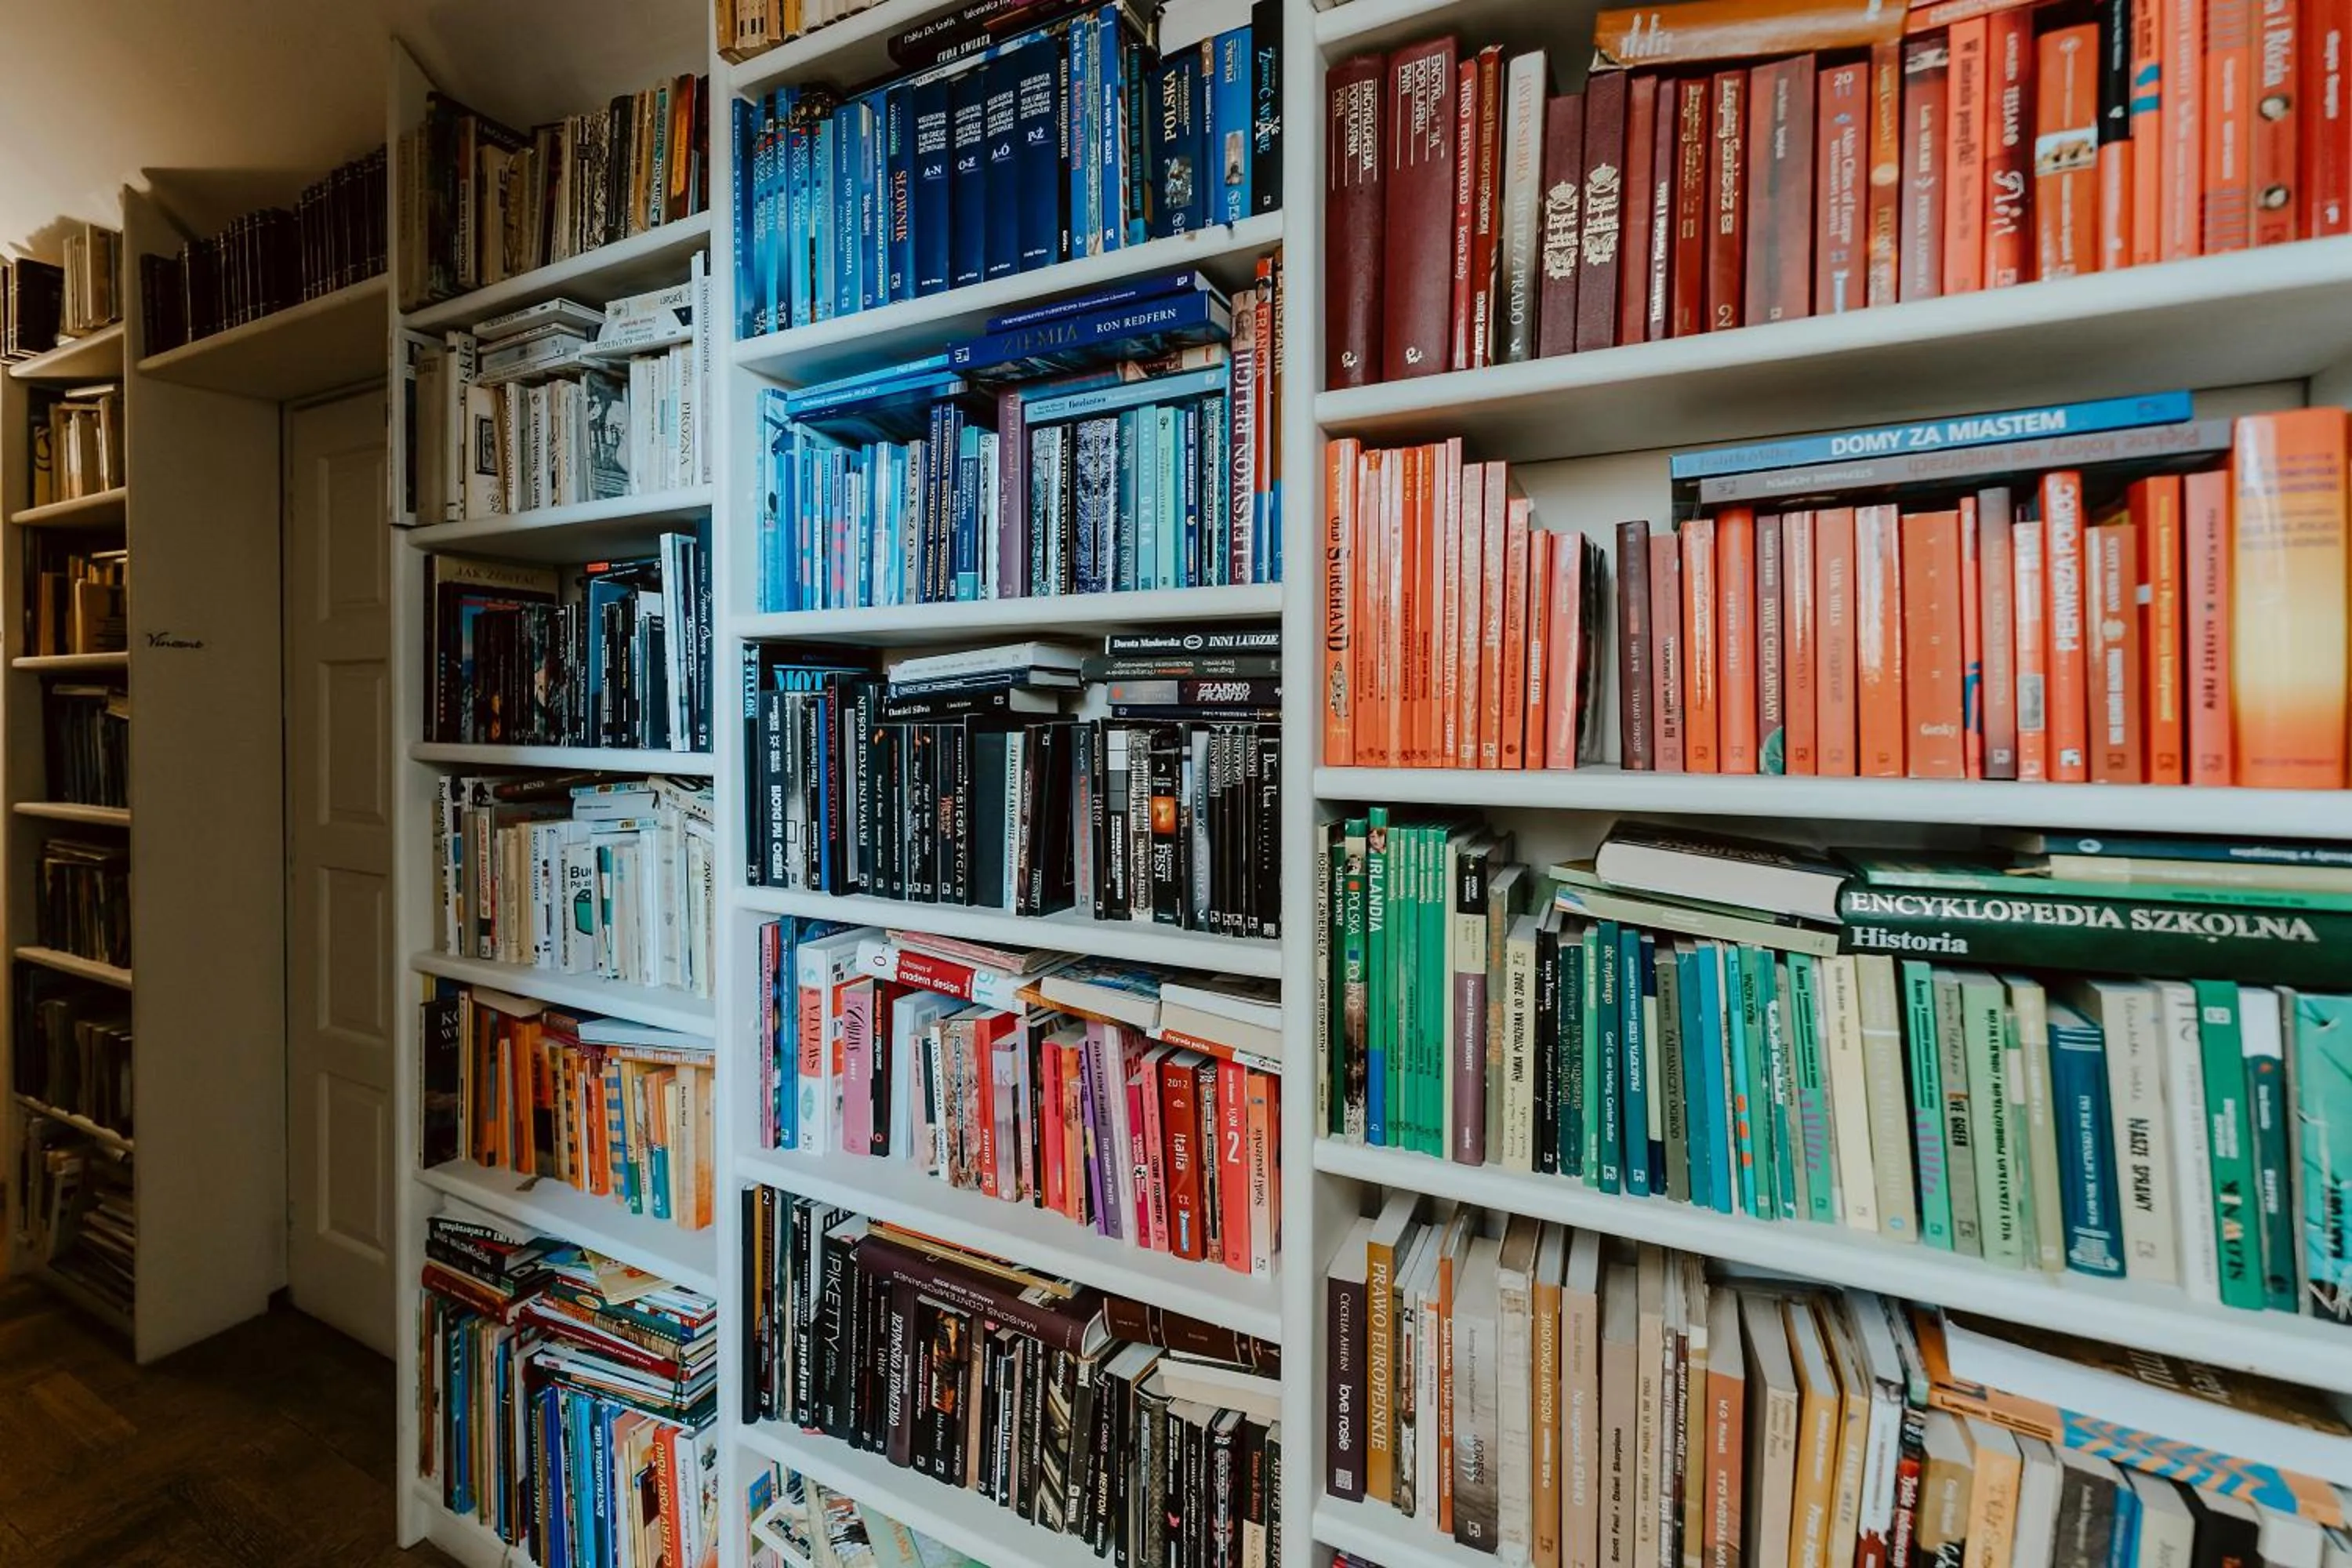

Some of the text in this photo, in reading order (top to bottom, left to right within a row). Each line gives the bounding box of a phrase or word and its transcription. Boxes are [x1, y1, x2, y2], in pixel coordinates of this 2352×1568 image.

[1224, 38, 1233, 83] POLSKA
[1401, 64, 1413, 94] PWN
[1162, 70, 1177, 143] POLSKA
[1335, 88, 1346, 117] PWN
[1348, 83, 1359, 157] POPULARNA
[1414, 59, 1427, 135] POPULARNA
[1461, 79, 1472, 118] WINO
[895, 171, 907, 241] SŁOWNIK
[1096, 308, 1177, 334] RON REDFERN
[1510, 270, 1525, 325] PRADO
[1255, 307, 1268, 377] FRANCJA
[1232, 354, 1252, 558] LEKSYKON RELIGII
[1831, 409, 2067, 457] DOMY ZA MIASTEM
[2050, 484, 2079, 652] PIERWSZA POMOC
[1327, 547, 1351, 652] SUREHAND
[1208, 635, 1234, 648] INNI
[1236, 633, 1280, 647] LUDZIE
[1763, 598, 1778, 723] KWIAT CIEPLARNIANY
[888, 705, 931, 717] Daniel Silva
[1196, 691, 1251, 702] PRAWDY
[1199, 681, 1250, 693] ZIARNO
[857, 696, 867, 846] PRYWATNE ŻYCIE ROŚLIN
[955, 786, 964, 838] KSIĘGA
[1093, 793, 1104, 826] Lektor
[771, 842, 782, 878] NIEBO
[1154, 844, 1167, 881] FEST
[1316, 853, 1327, 894] ROŚLINY
[1368, 859, 1384, 932] IRLANDIA
[1849, 891, 2318, 942] ENCYKLOPEDIA SZKOLNA
[1316, 903, 1327, 957] ZWIERZĘTA
[1347, 891, 1361, 1010] POLSKA POLAND
[1605, 945, 1615, 960] abc
[1851, 926, 1969, 955] Historia
[899, 971, 960, 994] modern design
[1167, 1077, 1187, 1088] 2012
[1562, 1040, 1571, 1105] PSYCHOLOGII
[1664, 1029, 1680, 1139] TAJEMNICZY OGRÓD
[1174, 1134, 1189, 1170] Italia
[1226, 1131, 1240, 1164] 2
[1950, 1117, 1969, 1146] GREEN
[2125, 1118, 2154, 1213] NASZE SPRAWY
[825, 1256, 841, 1352] PIKETTY
[892, 1271, 1037, 1330] MAISONS CONTEMPORAINES
[889, 1312, 903, 1427] RZYMSKA KOMEDIA
[1338, 1293, 1353, 1451] CECELIA AHERN love rosie
[1370, 1262, 1386, 1452] PRAWO EUROPEJSKIE
[1539, 1312, 1552, 1425] ROŚLINY POKOJOWE
[655, 1442, 667, 1476] ROKU
[1100, 1423, 1109, 1453] CAMUS
[659, 1481, 670, 1514] PORY
[1097, 1471, 1109, 1515] MERTON
[1717, 1469, 1727, 1494] KTO
